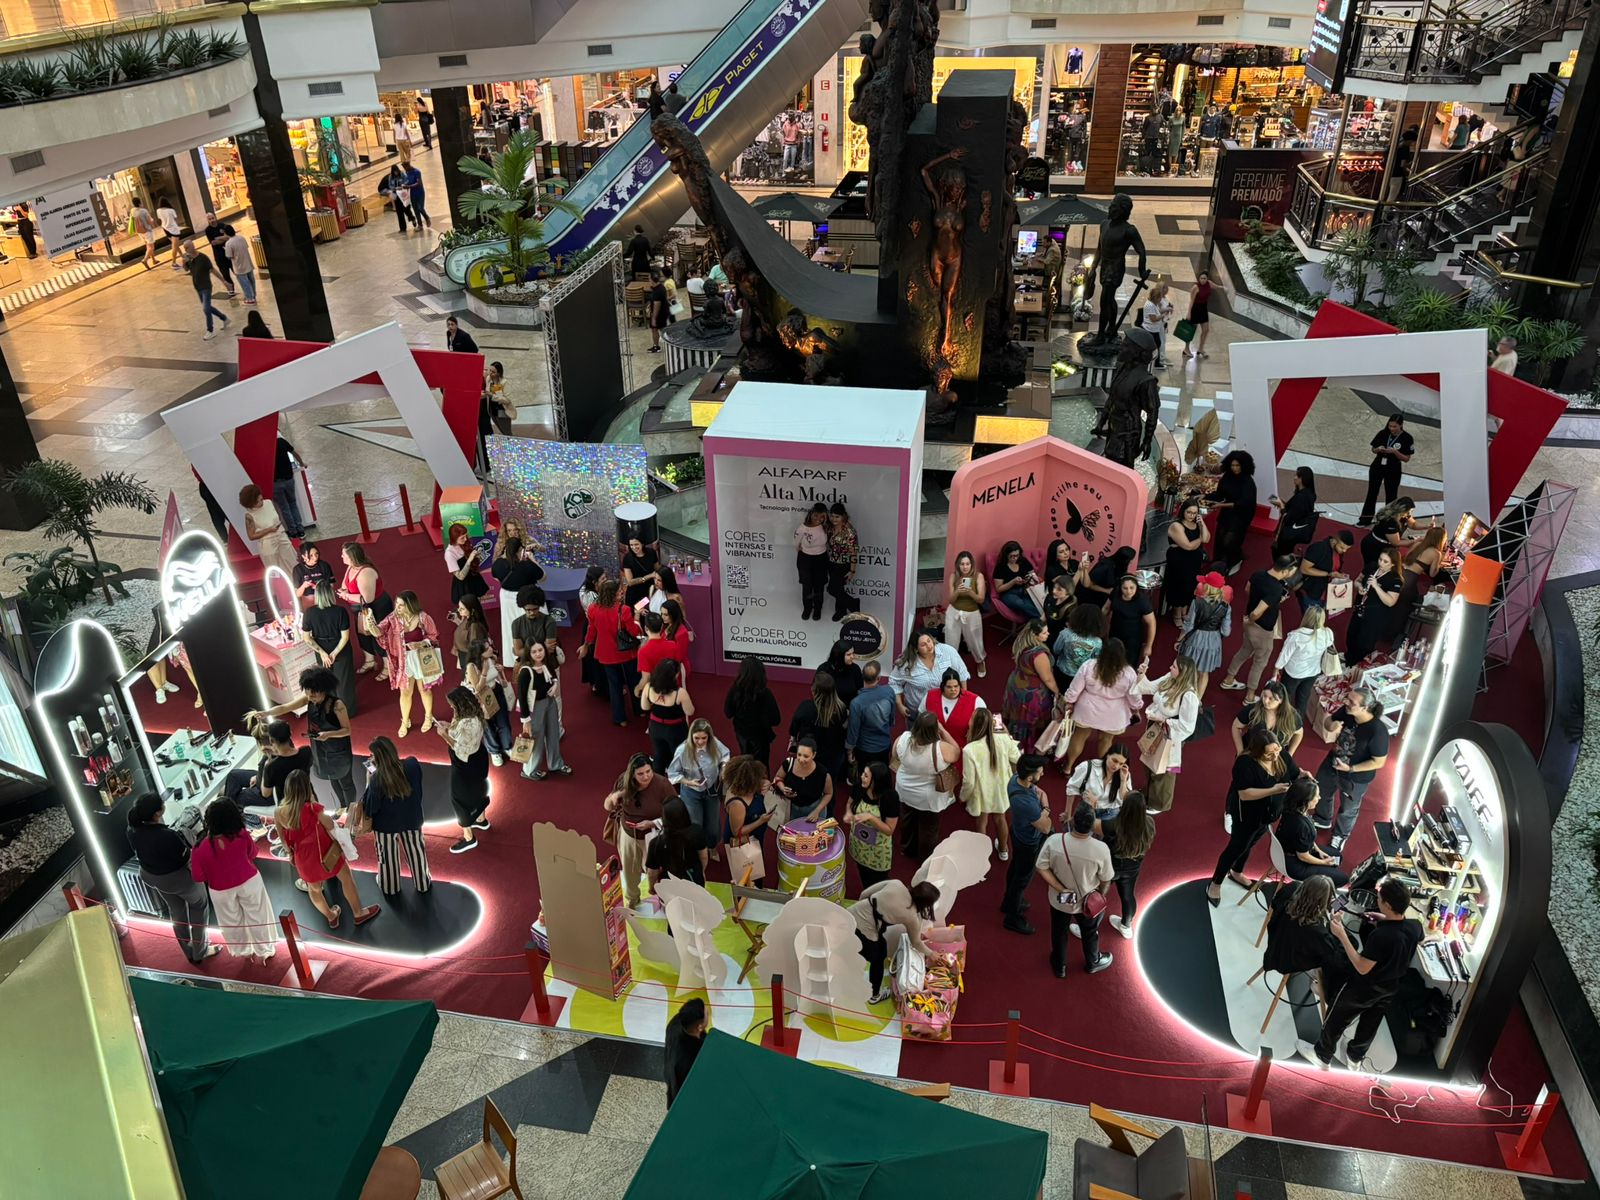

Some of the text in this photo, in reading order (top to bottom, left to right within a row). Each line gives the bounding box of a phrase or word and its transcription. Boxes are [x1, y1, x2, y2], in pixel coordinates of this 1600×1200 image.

[725, 41, 764, 84] PIAGET
[1233, 173, 1286, 188] PERFUME
[758, 466, 848, 481] ALFAPARF
[759, 483, 848, 504] Alta Moda
[1051, 480, 1079, 503] Trilhe
[1083, 483, 1102, 500] seu
[760, 504, 790, 512] Tecnologia
[725, 530, 766, 542] CORES
[725, 542, 765, 550] INTENSAS
[726, 550, 774, 559] VIBRANTES!
[849, 578, 890, 588] NOLOGIA
[859, 589, 890, 597] BLOCK
[728, 596, 767, 607] FILTRO
[729, 608, 744, 616] UV
[730, 626, 807, 640] O PODER DO
[730, 635, 754, 643] ÁCIDO
[1452, 743, 1494, 823] TAIFF
